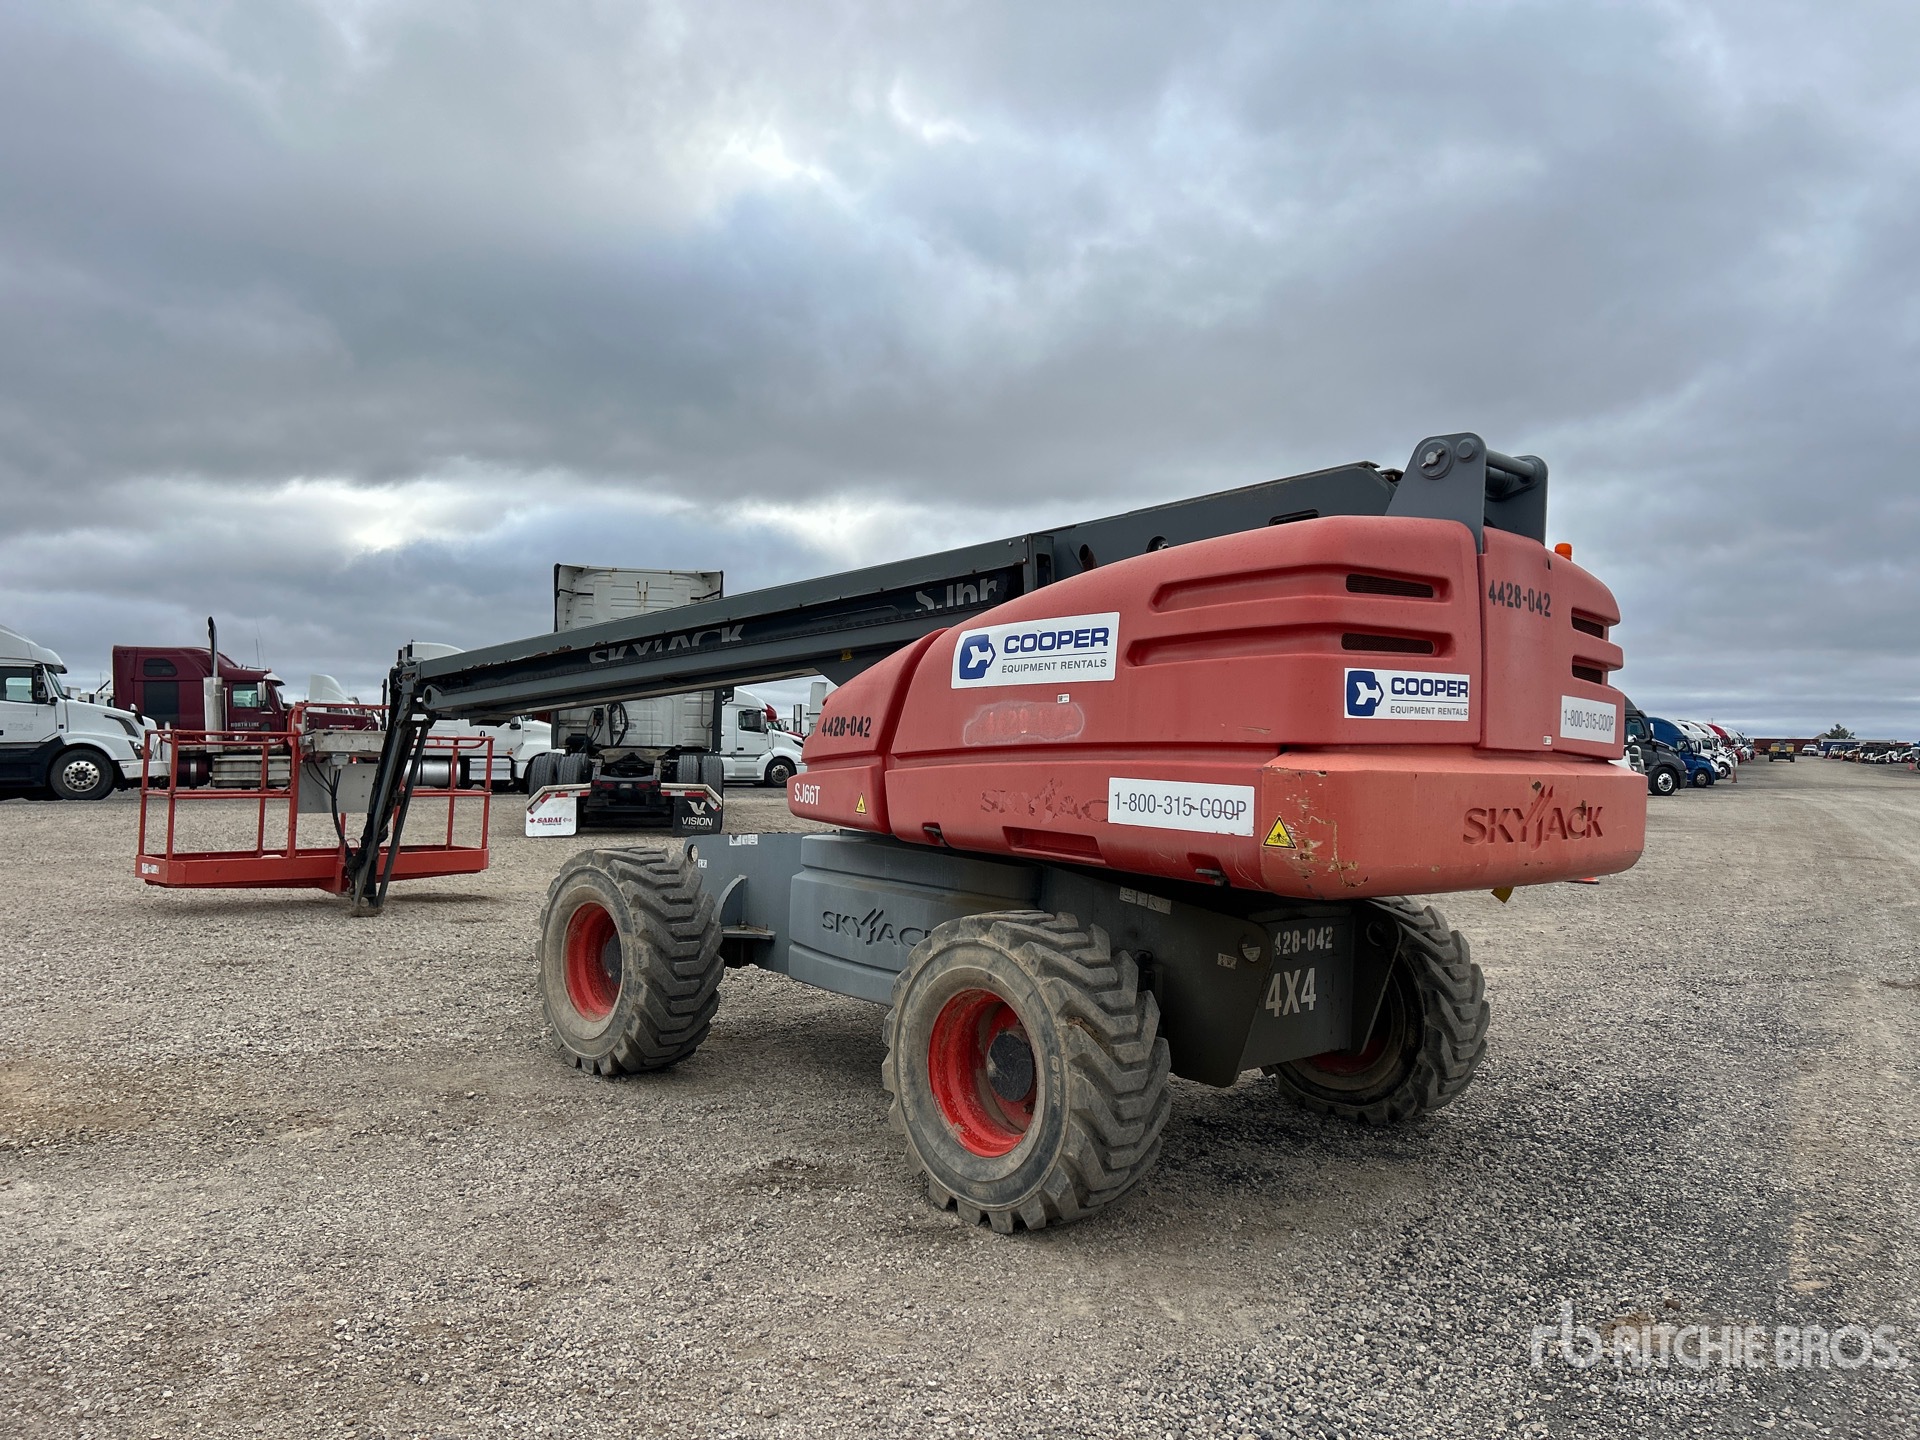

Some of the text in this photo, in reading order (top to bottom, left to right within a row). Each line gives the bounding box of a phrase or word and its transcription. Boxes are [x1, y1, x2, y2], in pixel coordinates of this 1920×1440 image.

[1488, 579, 1551, 618] 4428-042
[1003, 627, 1110, 654] COOPER
[1001, 658, 1107, 674] EQUIPMENT RENTALS
[1390, 676, 1469, 698] COOPER
[1390, 705, 1468, 716] EQUIPMENT RENTALS
[1563, 708, 1615, 732] 1-800-315-COOP
[821, 715, 872, 738] 4428-042
[794, 782, 821, 806] SJ66T
[1113, 791, 1248, 821] 1-800-315-COOP
[681, 816, 713, 826] VISION
[1462, 784, 1604, 851] SKYJACK
[1274, 926, 1334, 956] 428-042
[1265, 967, 1317, 1018] 4X4
